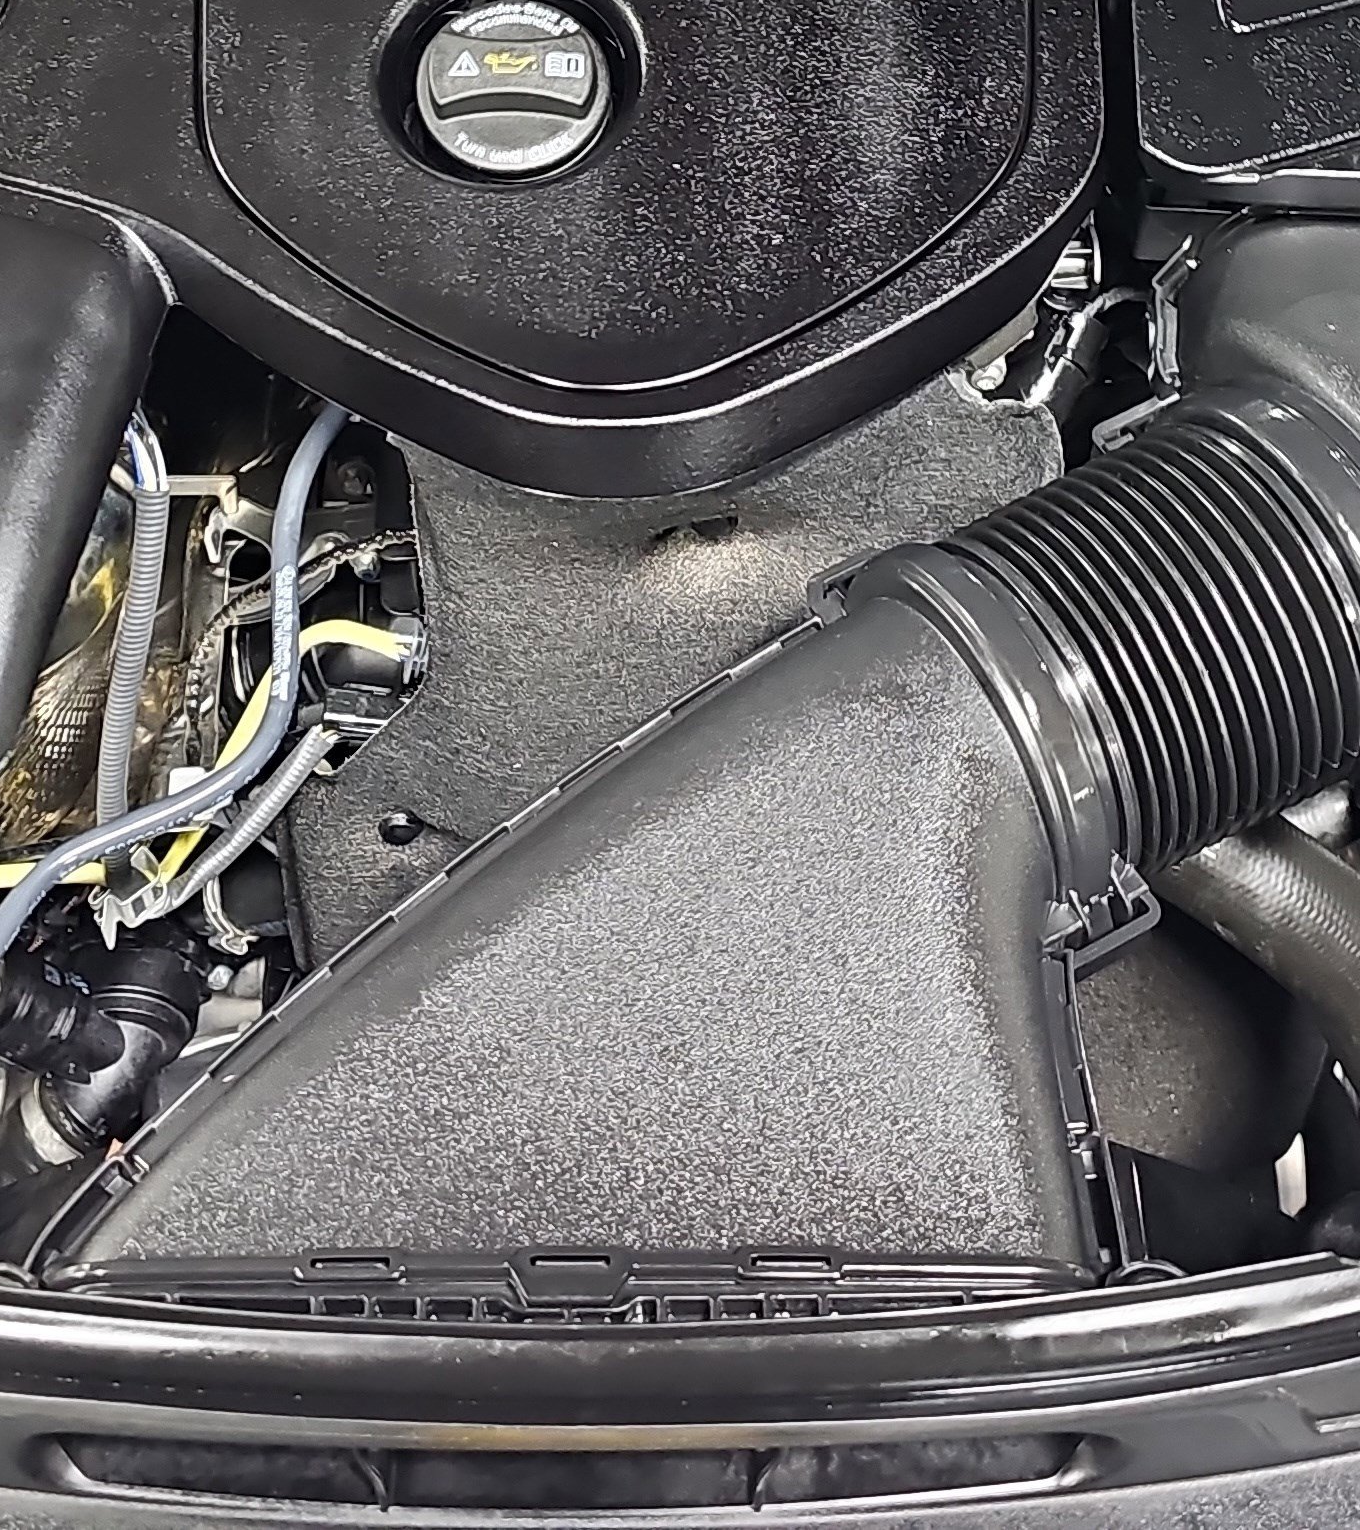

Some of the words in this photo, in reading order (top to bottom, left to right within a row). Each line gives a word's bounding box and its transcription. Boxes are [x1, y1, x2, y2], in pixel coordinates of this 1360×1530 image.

[450, 2, 561, 33] Mercedes-Benz
[469, 13, 563, 37] recommended
[454, 130, 487, 159] Turn
